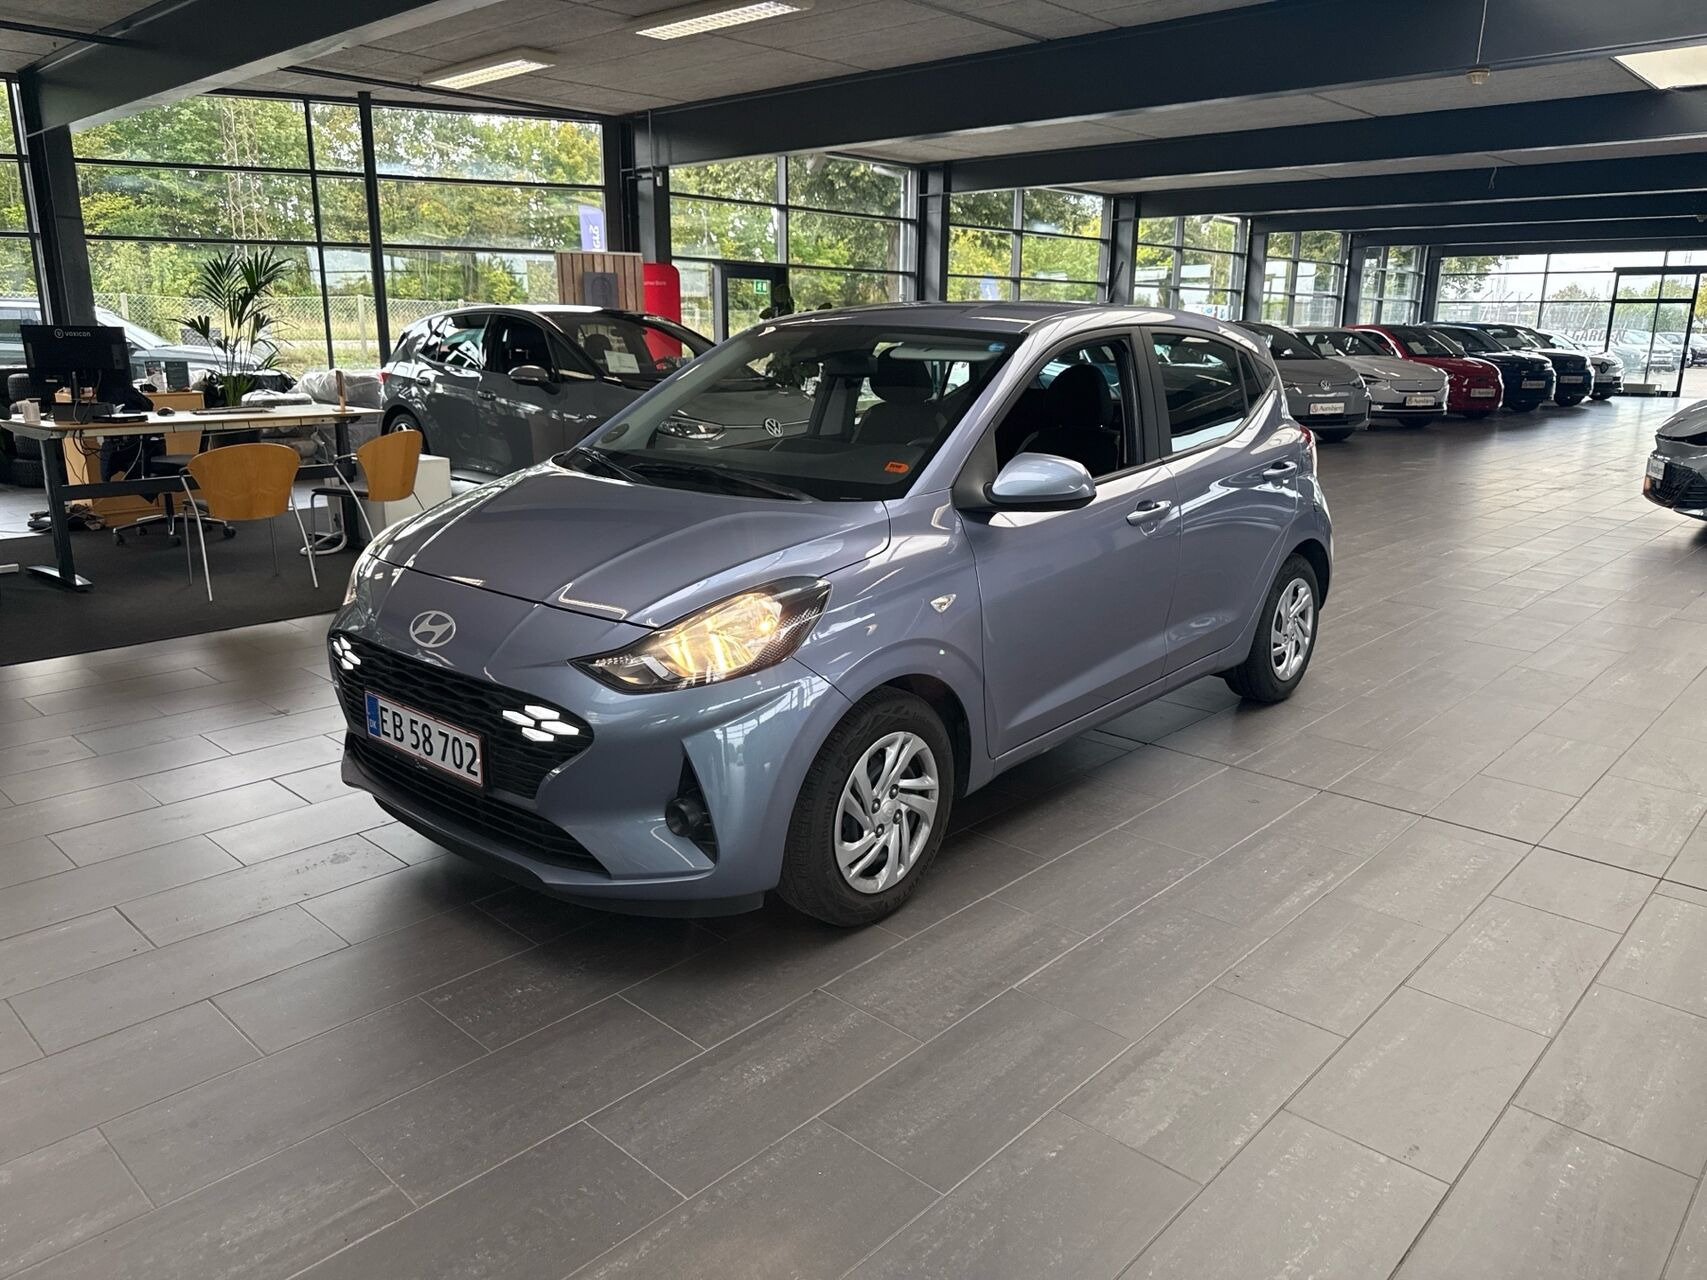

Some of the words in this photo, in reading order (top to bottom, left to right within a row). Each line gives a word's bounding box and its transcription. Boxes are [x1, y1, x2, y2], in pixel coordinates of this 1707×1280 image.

[380, 705, 404, 743] EB
[410, 718, 434, 756] 58
[438, 730, 478, 777] 702
